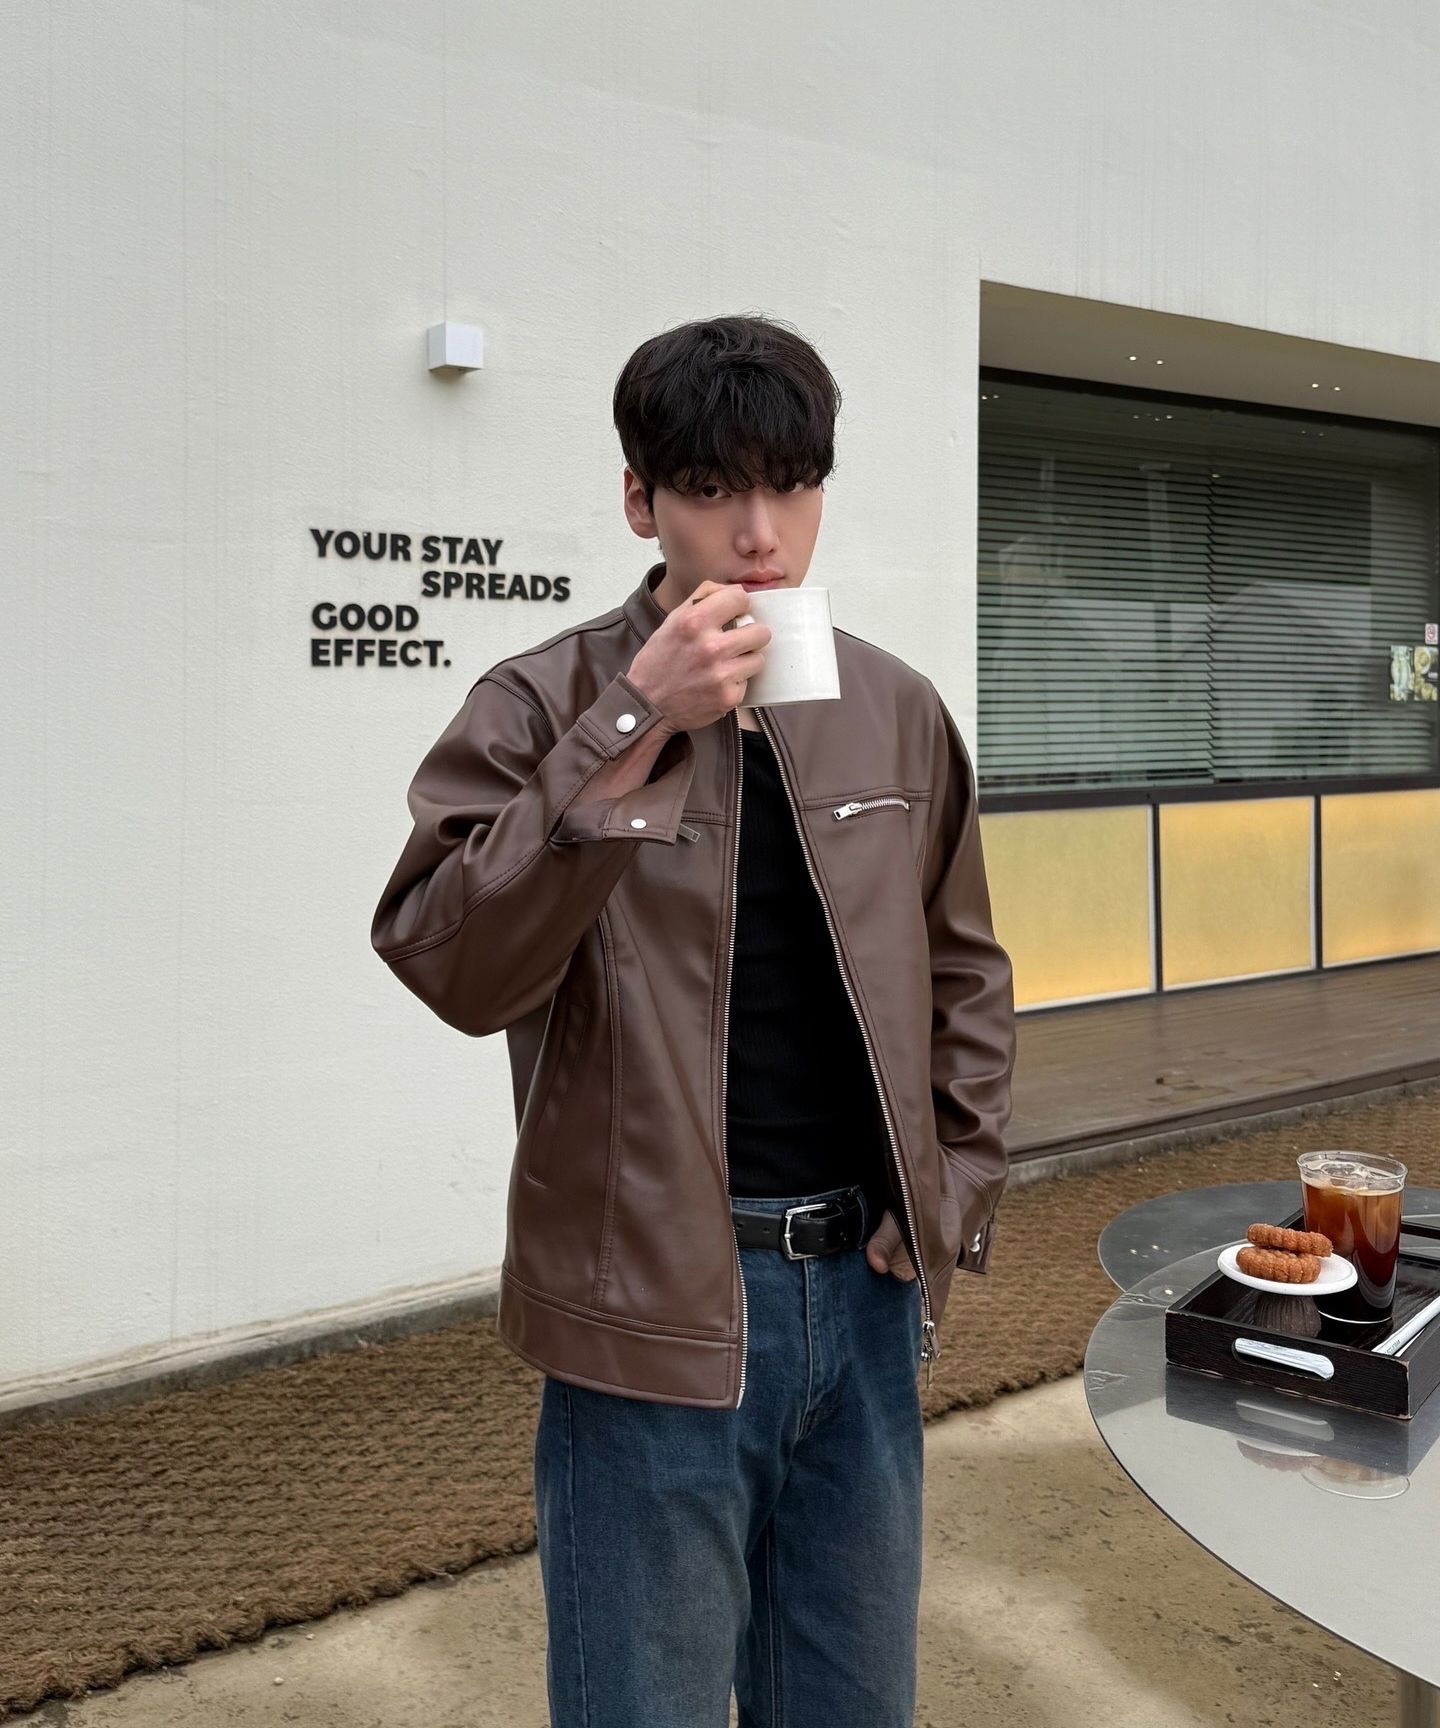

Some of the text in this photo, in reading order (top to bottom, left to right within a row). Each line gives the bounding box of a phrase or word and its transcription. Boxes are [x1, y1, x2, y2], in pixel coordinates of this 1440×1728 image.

[310, 528, 503, 566] YOUR STAY
[421, 570, 571, 603] SPREADS
[311, 602, 419, 632] GOOD
[311, 638, 452, 667] EFFECT.
